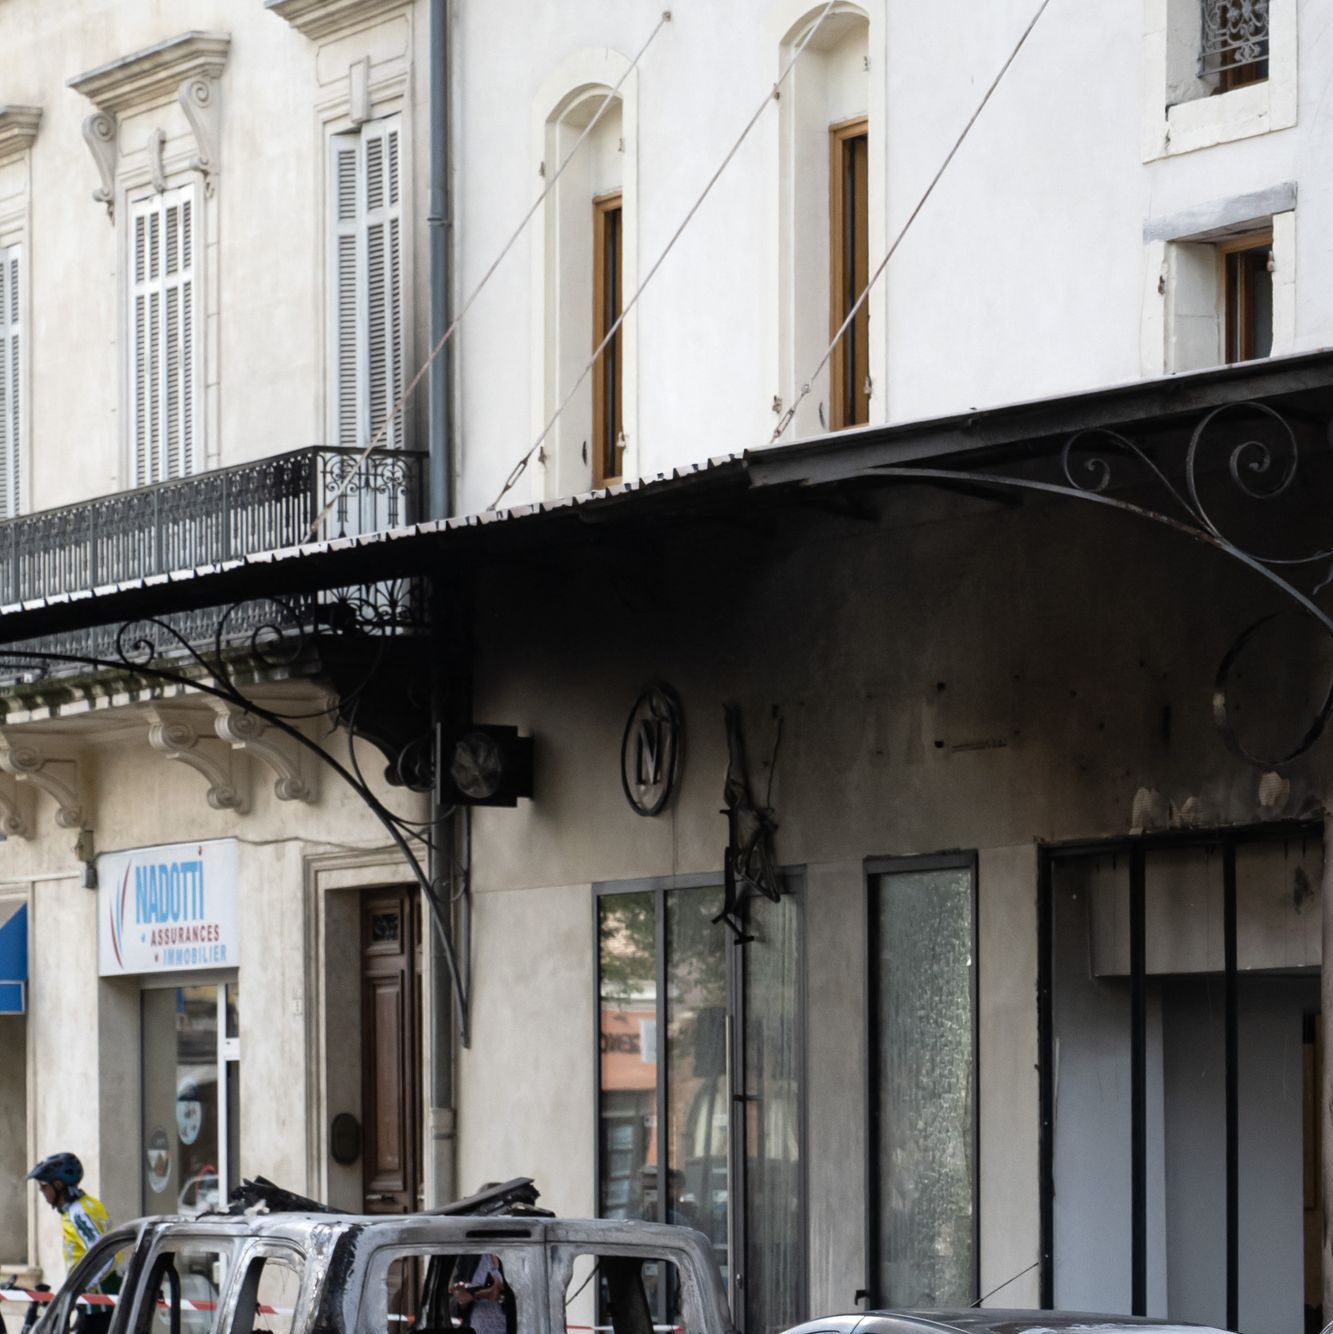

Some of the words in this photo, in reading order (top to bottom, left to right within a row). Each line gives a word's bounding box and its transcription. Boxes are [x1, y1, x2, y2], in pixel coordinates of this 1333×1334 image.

[135, 860, 204, 925] NADOTTI
[150, 924, 220, 947] ASSURANCES
[163, 944, 227, 966] IMMOBILIER
